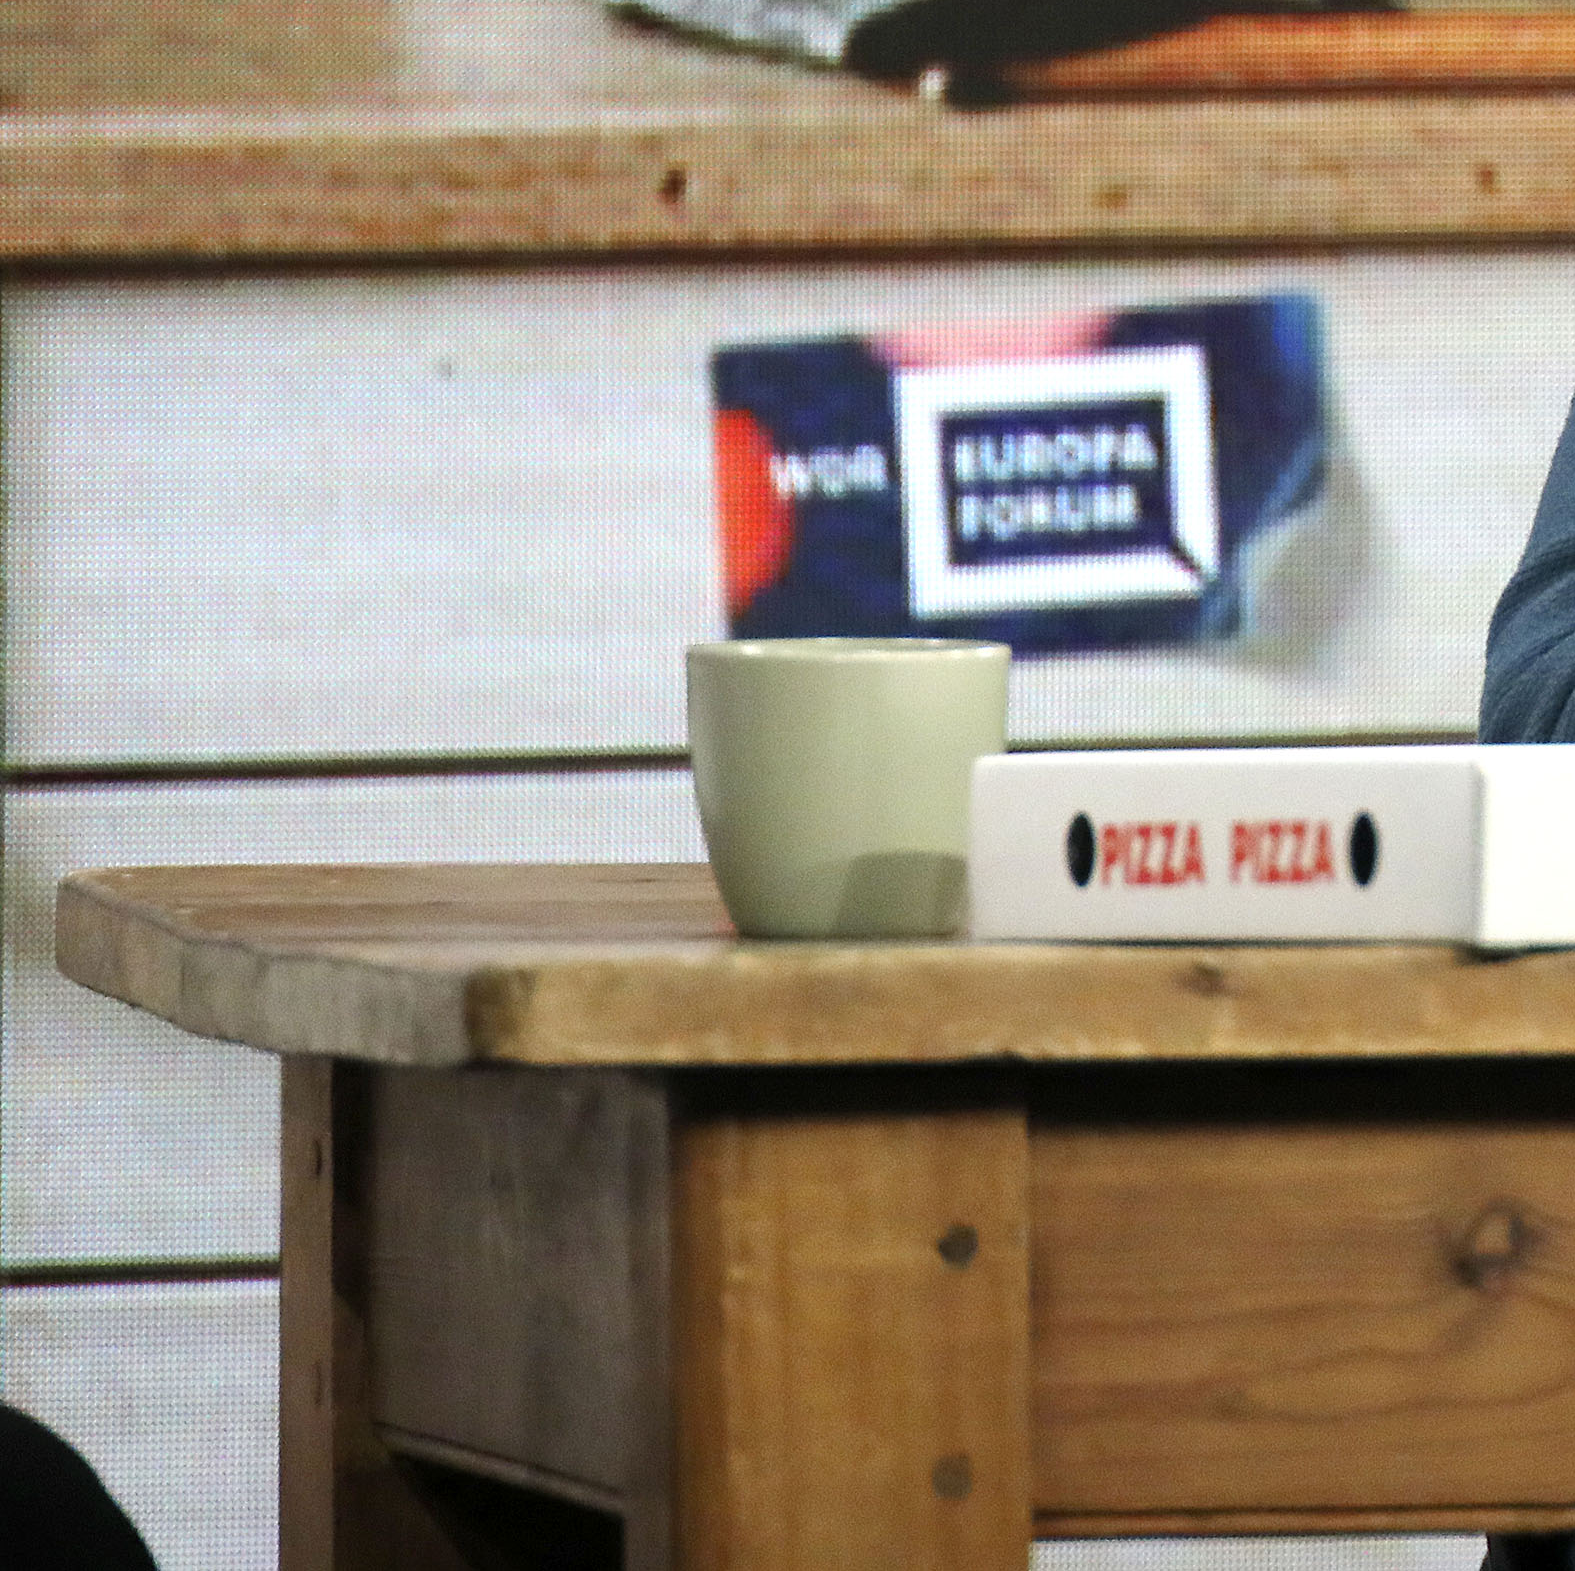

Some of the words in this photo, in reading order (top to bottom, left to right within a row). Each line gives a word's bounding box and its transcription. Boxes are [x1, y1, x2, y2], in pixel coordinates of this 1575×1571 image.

[769, 443, 889, 500] WDR
[953, 422, 1158, 482] EUROPA
[954, 483, 1141, 543] FORUM
[1100, 823, 1203, 886] PIZZA
[1231, 822, 1334, 884] PIZZA
